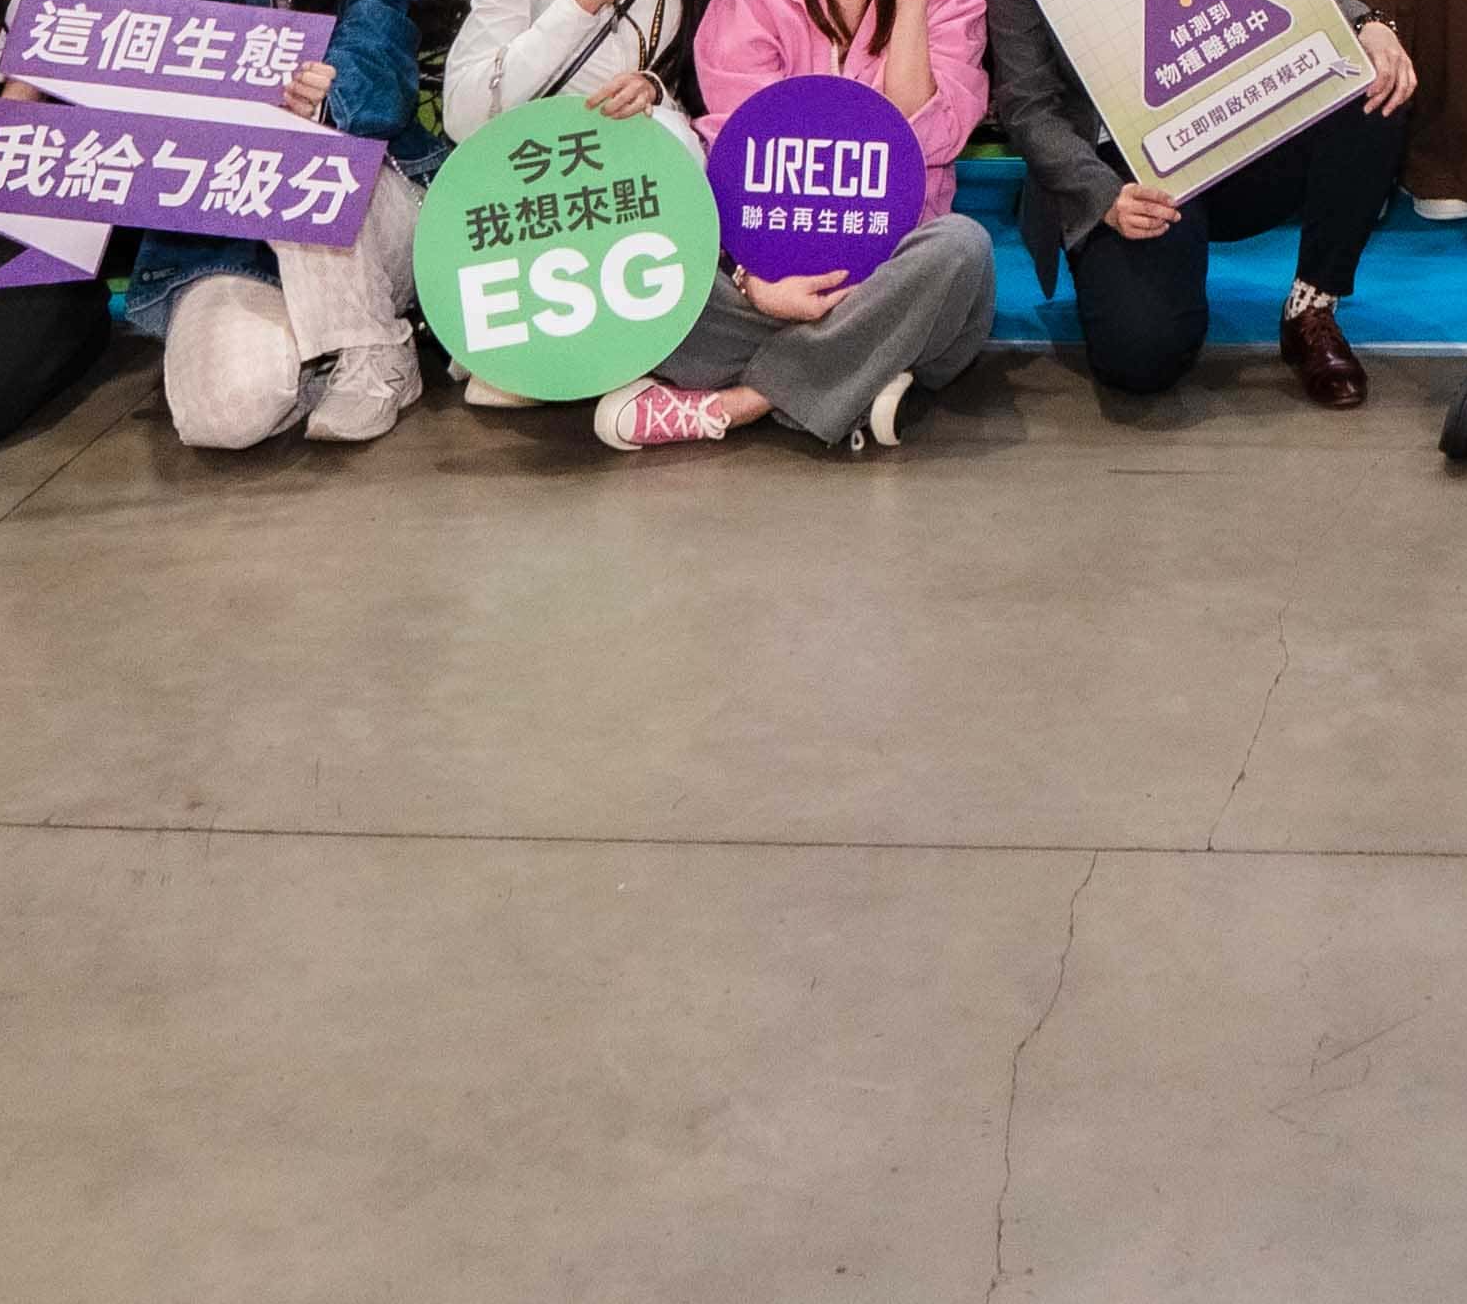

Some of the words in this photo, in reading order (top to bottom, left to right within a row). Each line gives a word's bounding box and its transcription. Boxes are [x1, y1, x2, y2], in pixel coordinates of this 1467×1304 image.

[21, 0, 305, 88] 這個生態
[1154, 9, 1270, 89] 物種離線中
[1170, 1, 1231, 49] 偵測到
[507, 129, 604, 184] 今天
[744, 136, 889, 199] URECO
[465, 174, 660, 252] 我想來點
[741, 205, 890, 235] 聯合再生能源
[457, 232, 685, 353] ESG
